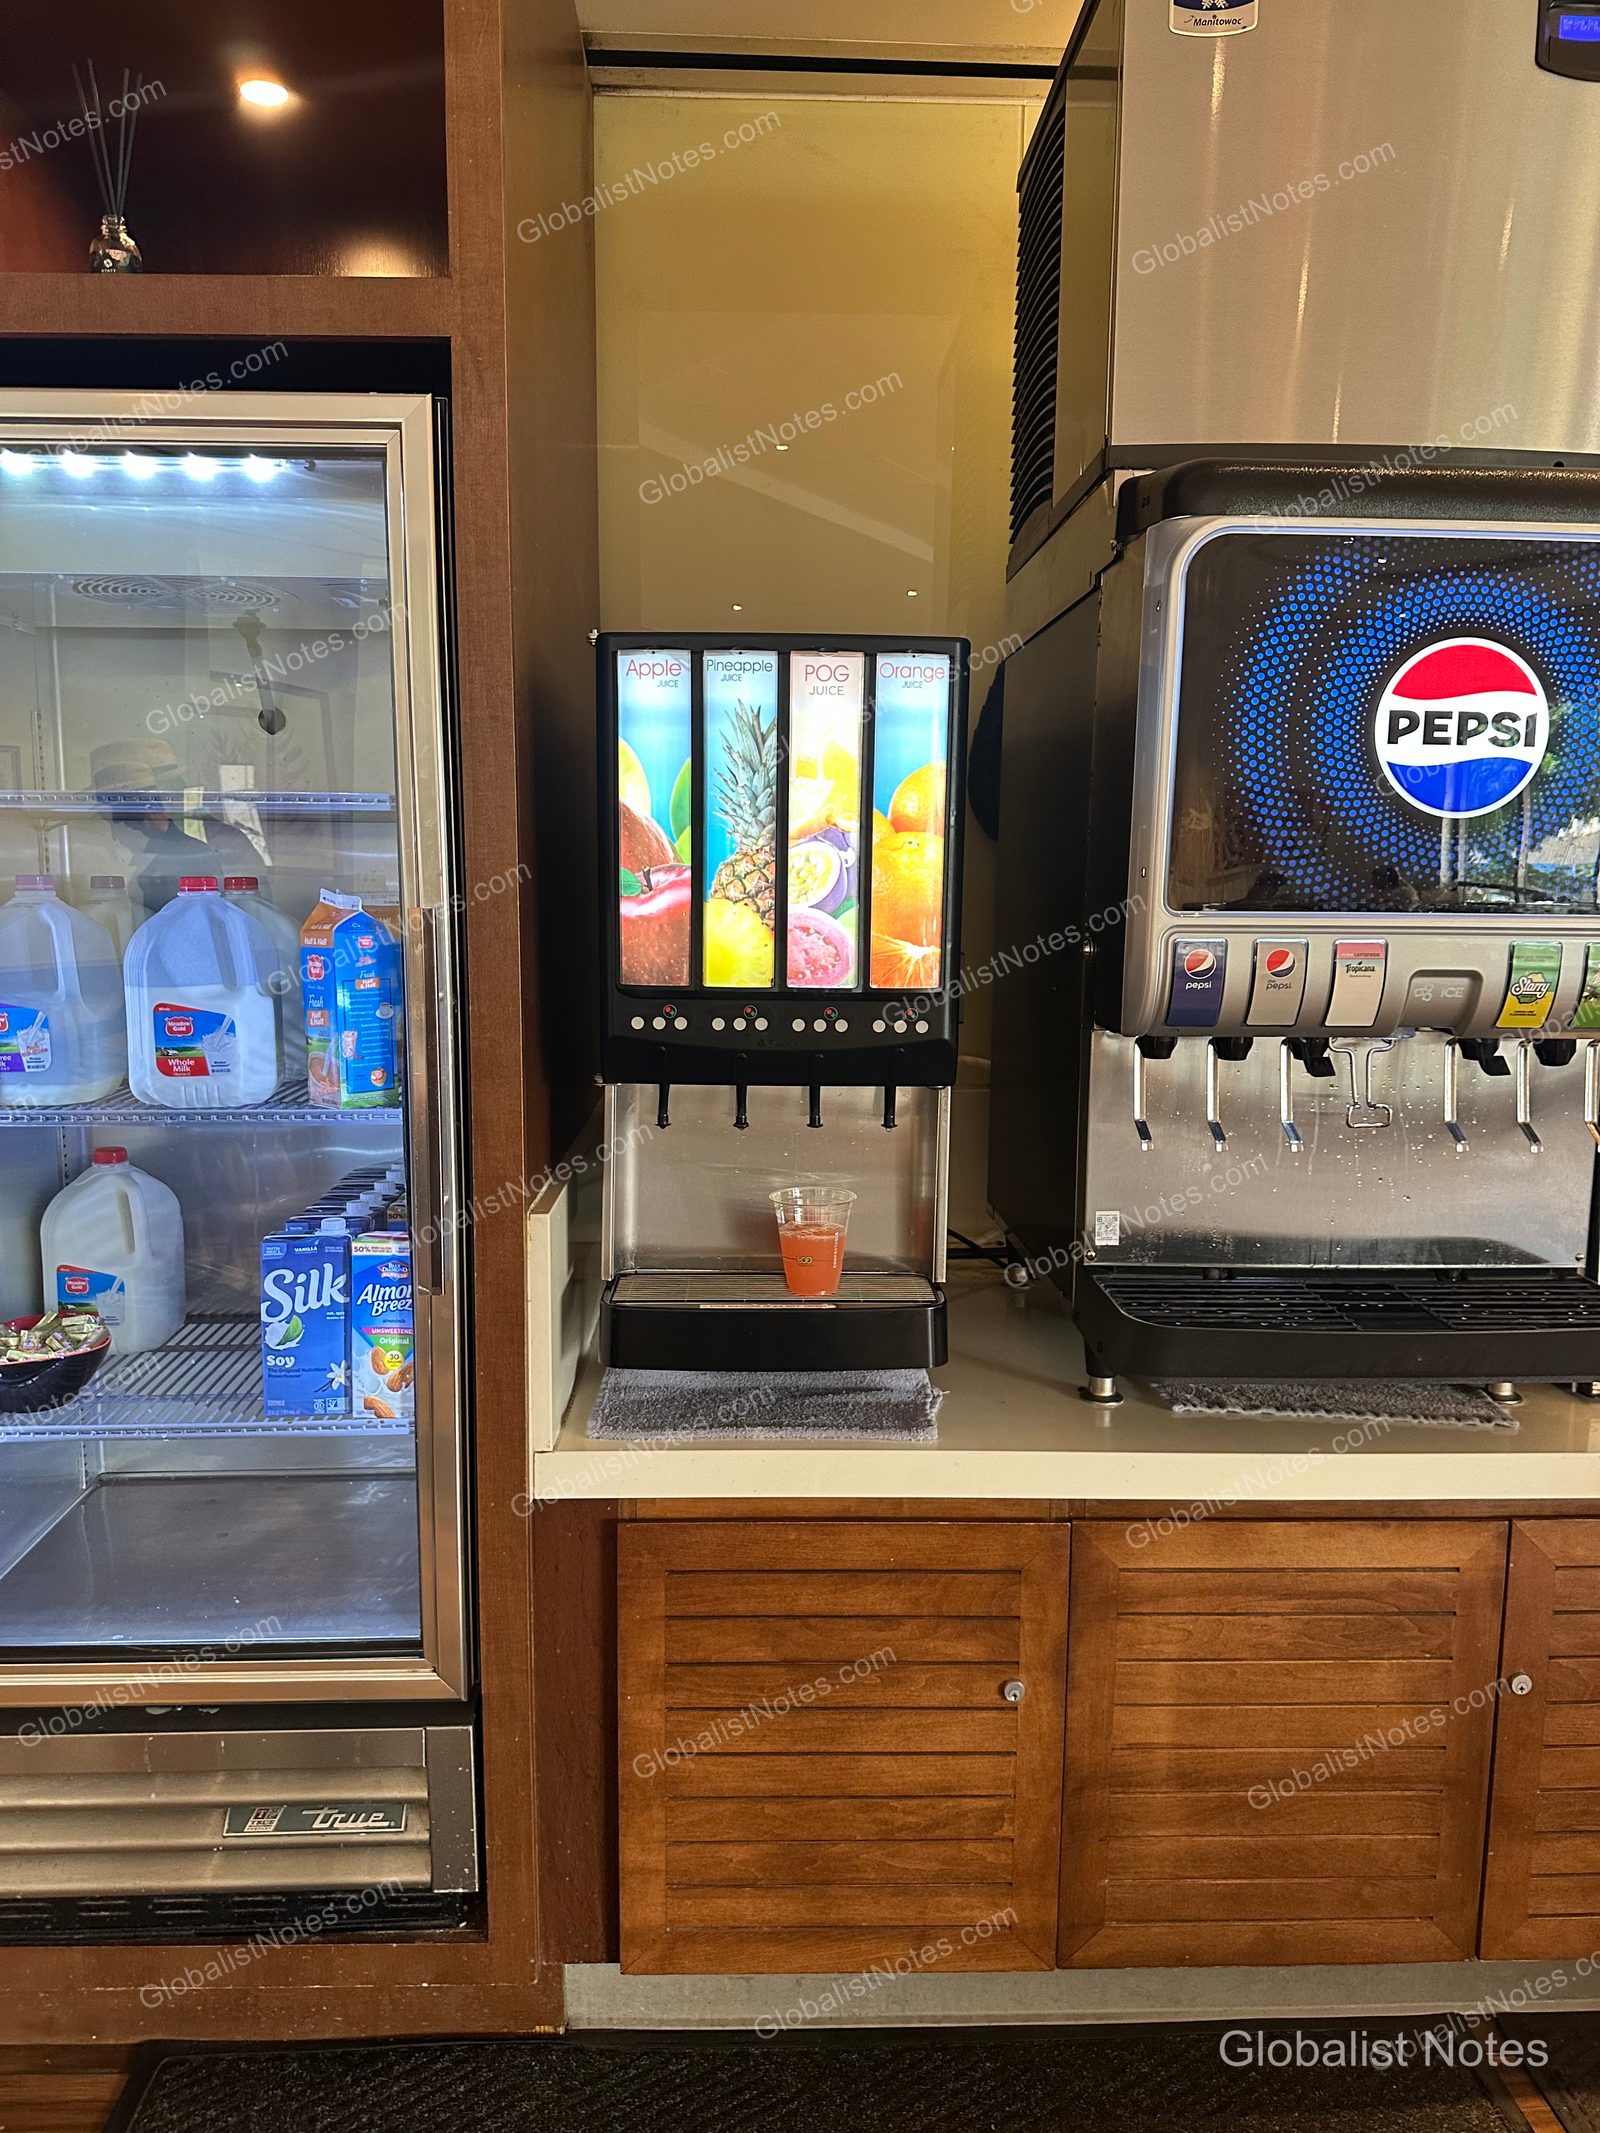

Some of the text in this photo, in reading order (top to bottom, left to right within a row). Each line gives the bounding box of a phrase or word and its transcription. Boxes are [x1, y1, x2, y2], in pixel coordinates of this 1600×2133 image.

[1193, 17, 1242, 26] Manitowoc
[626, 659, 682, 679] Apple
[706, 659, 773, 675] Pineapple
[879, 662, 945, 684] Orange
[720, 673, 742, 682] JUICE
[804, 664, 850, 683] POG
[657, 679, 679, 688] JUICE
[901, 680, 923, 689] JUICE
[809, 685, 845, 696] JUICE
[1387, 710, 1538, 748] PEPSI
[1345, 961, 1376, 973] Tropicana
[1185, 980, 1212, 990] pepsi
[1265, 981, 1292, 990] pepsi
[1511, 976, 1551, 999] Starry
[1440, 986, 1465, 998] ICE
[261, 1262, 350, 1323] Silk
[371, 1299, 413, 1317] Breez
[379, 1337, 410, 1345] Original
